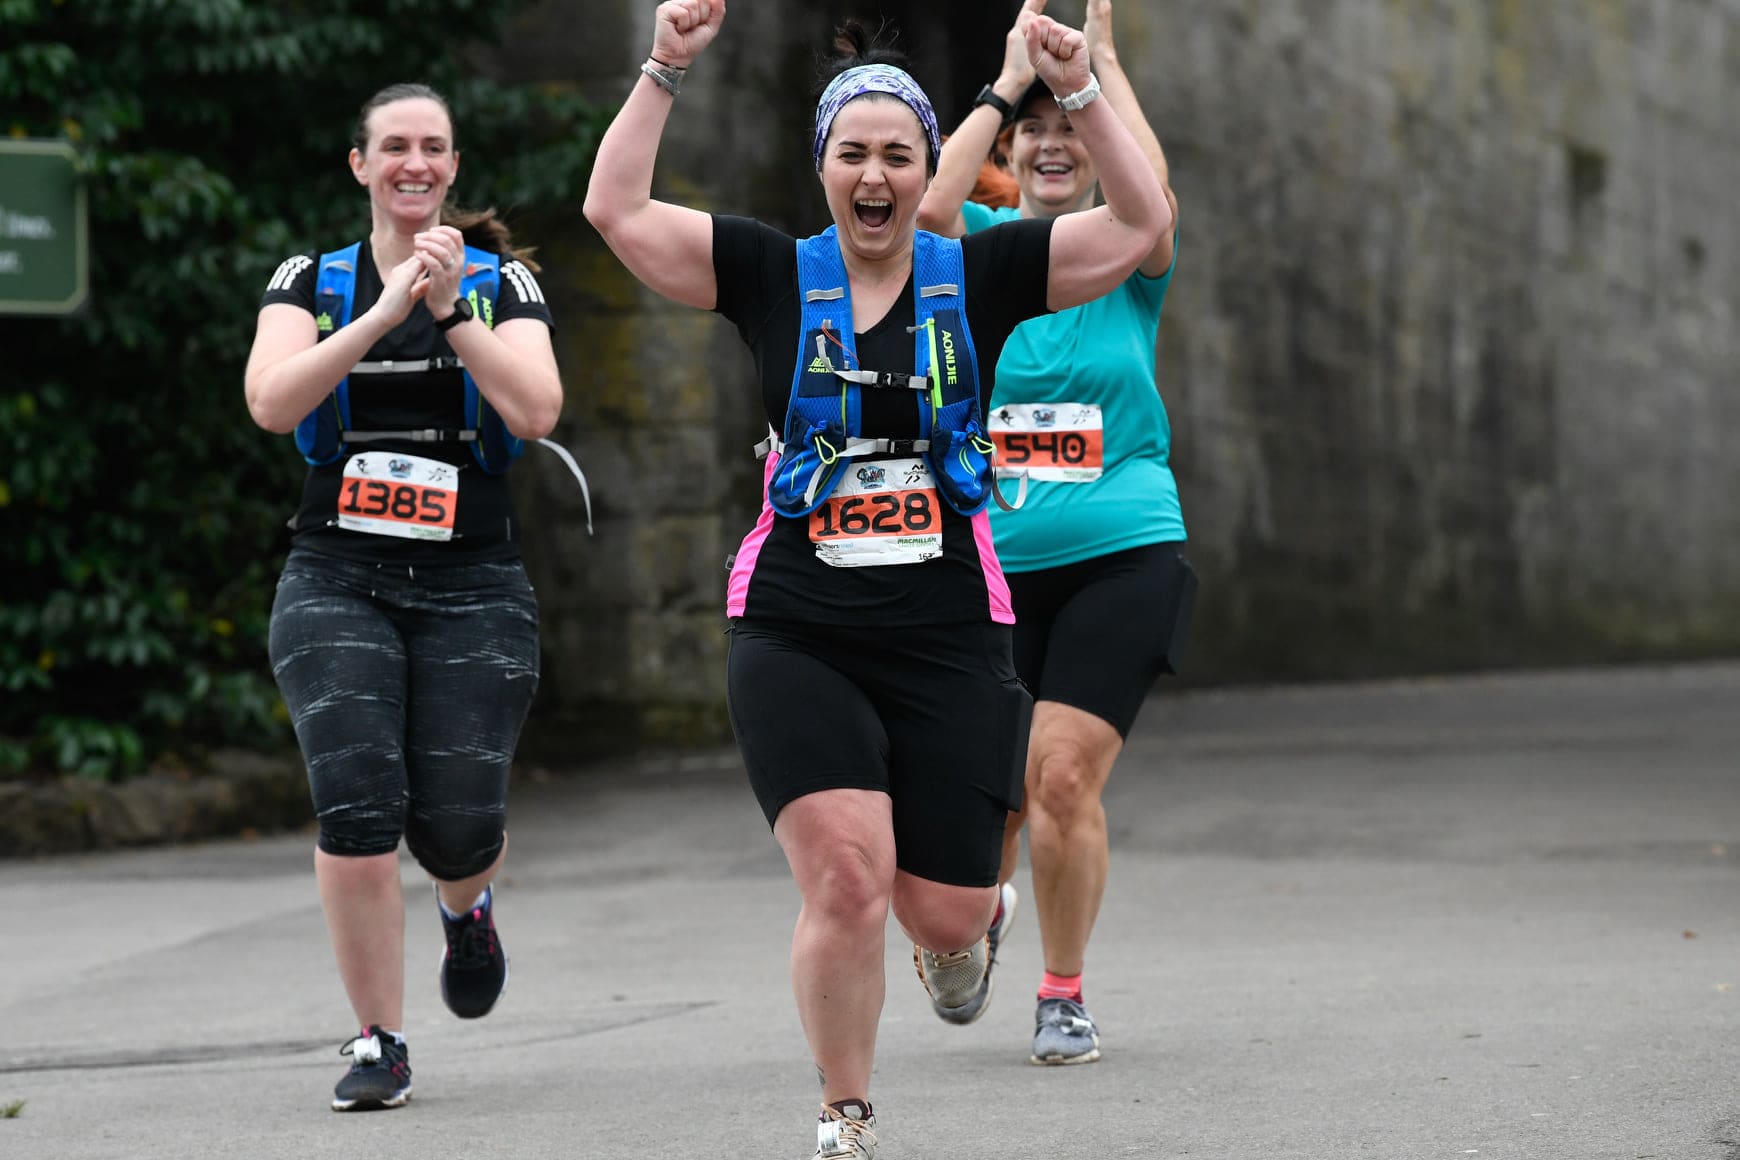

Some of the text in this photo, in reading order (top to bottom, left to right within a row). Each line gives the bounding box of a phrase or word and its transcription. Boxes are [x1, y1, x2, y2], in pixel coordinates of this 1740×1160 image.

[941, 329, 957, 385] AONIJIE
[1004, 433, 1087, 464] 540
[343, 480, 447, 523] 1385
[816, 492, 932, 537] 1628
[897, 536, 937, 545] MACMILLAN
